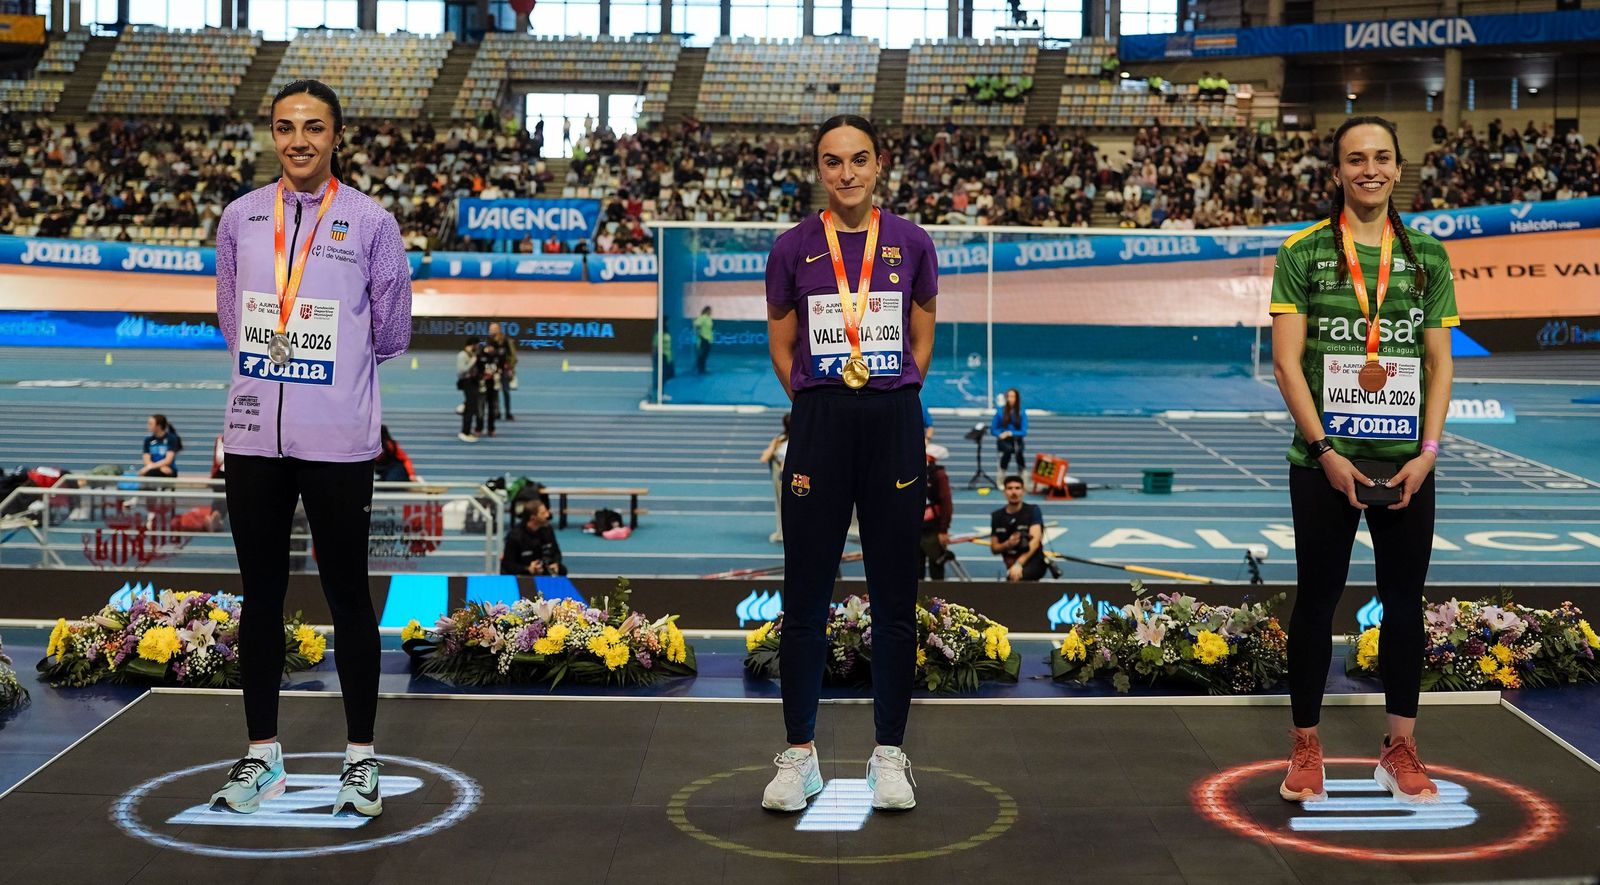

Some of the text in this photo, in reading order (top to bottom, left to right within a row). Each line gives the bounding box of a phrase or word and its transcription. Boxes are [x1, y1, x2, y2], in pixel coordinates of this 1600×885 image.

[1345, 18, 1477, 49] VALENCIA
[468, 206, 588, 231] VALENCIA
[20, 240, 101, 264] Joma
[122, 247, 204, 271] Joma
[1015, 239, 1095, 266] Joma
[1119, 236, 1200, 260] Joma
[601, 255, 658, 280] Jom
[704, 251, 768, 277] Jom
[1506, 264, 1547, 278] DE
[147, 321, 216, 338] Iberdrola
[535, 321, 615, 338] ESPAÑA
[875, 325, 900, 341] 2026
[301, 333, 332, 350] 2026
[1396, 347, 1415, 355] agua
[259, 357, 328, 380] Joma
[836, 353, 900, 375] Jma
[1328, 388, 1416, 406] VALENCIA 2026
[1348, 416, 1412, 435] Joma
